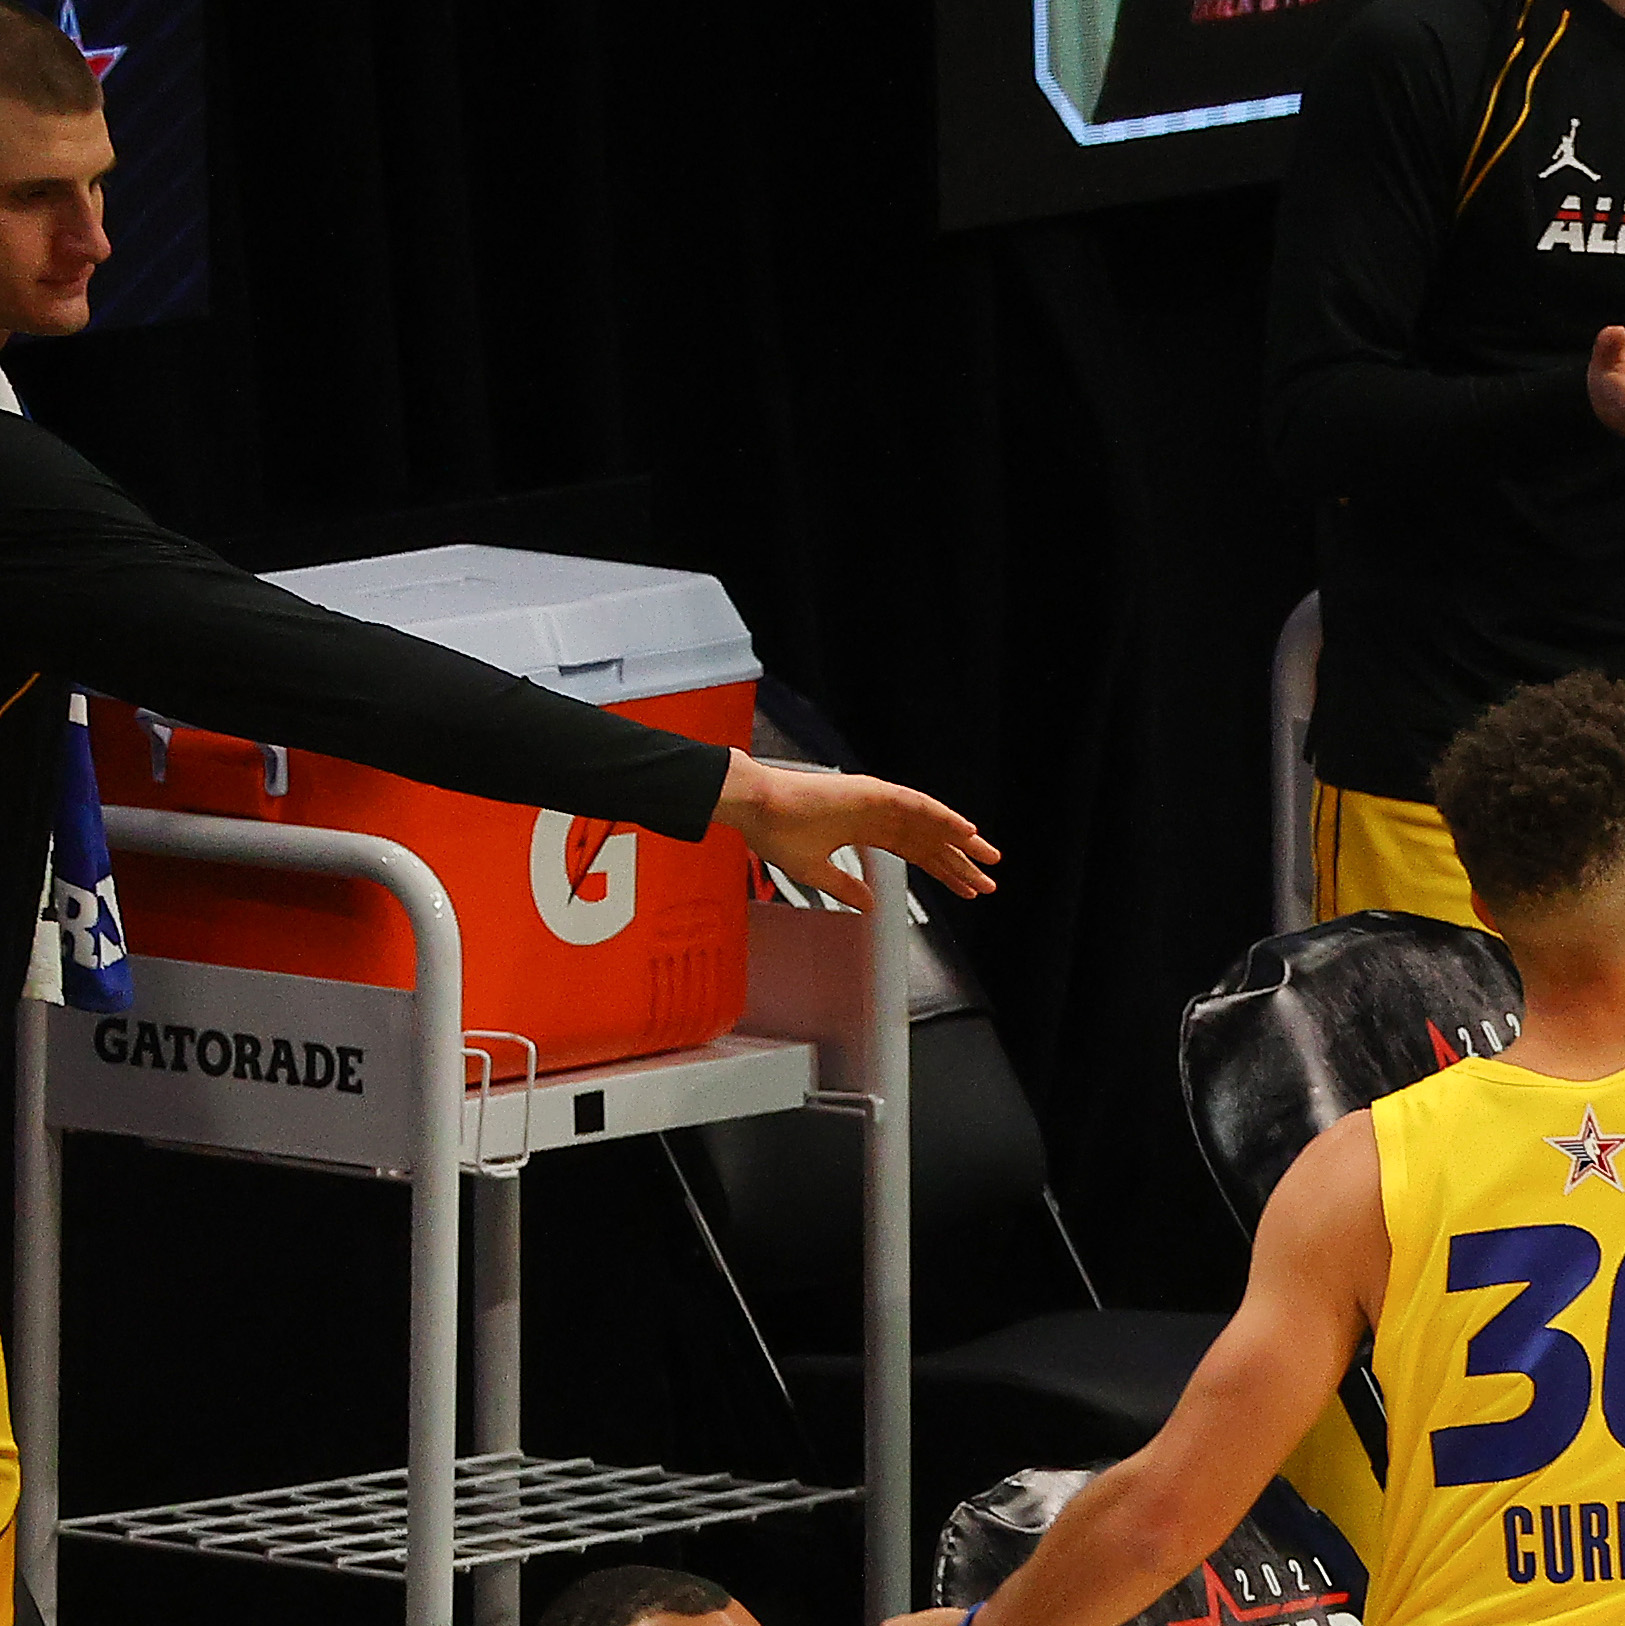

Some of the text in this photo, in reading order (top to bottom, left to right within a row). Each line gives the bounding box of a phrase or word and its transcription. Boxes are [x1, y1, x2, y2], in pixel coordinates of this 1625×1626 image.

[94, 1017, 363, 1094] GATORADE
[1457, 1012, 1521, 1058] 202
[1234, 1556, 1334, 1602] 2021
